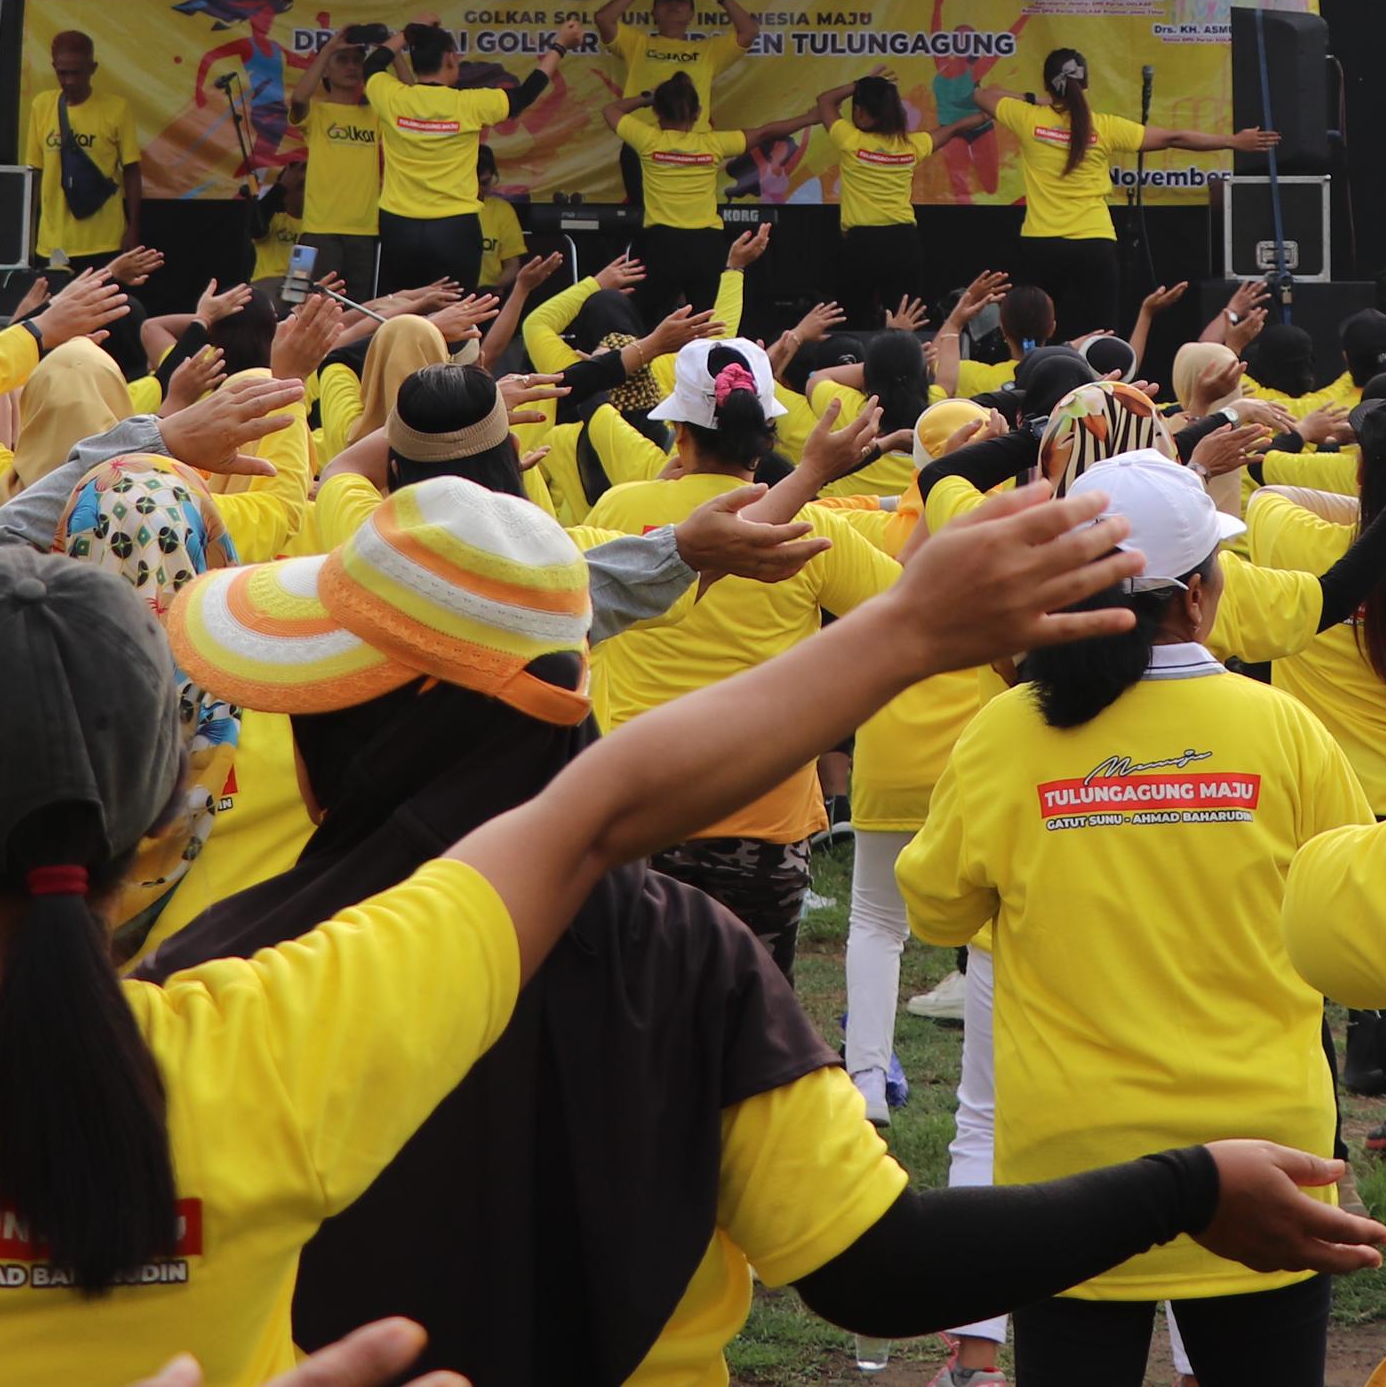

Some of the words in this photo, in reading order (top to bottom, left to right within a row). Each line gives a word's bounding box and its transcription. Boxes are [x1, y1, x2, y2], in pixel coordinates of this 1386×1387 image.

[464, 10, 548, 25] GOLKAR
[553, 10, 598, 25] SOL
[697, 11, 810, 26] INDNESIA
[816, 12, 873, 26] MAJU
[791, 32, 1015, 55] TULUNGAGUNG
[723, 209, 759, 222] KORG
[1044, 783, 1195, 808] TULUNGAGUNG
[1199, 781, 1255, 800] MAJU
[1046, 816, 1087, 831] GATUT
[1089, 814, 1123, 827] SUNU
[1132, 812, 1181, 824] AHMAD
[1182, 810, 1254, 824] BAHARUDIN
